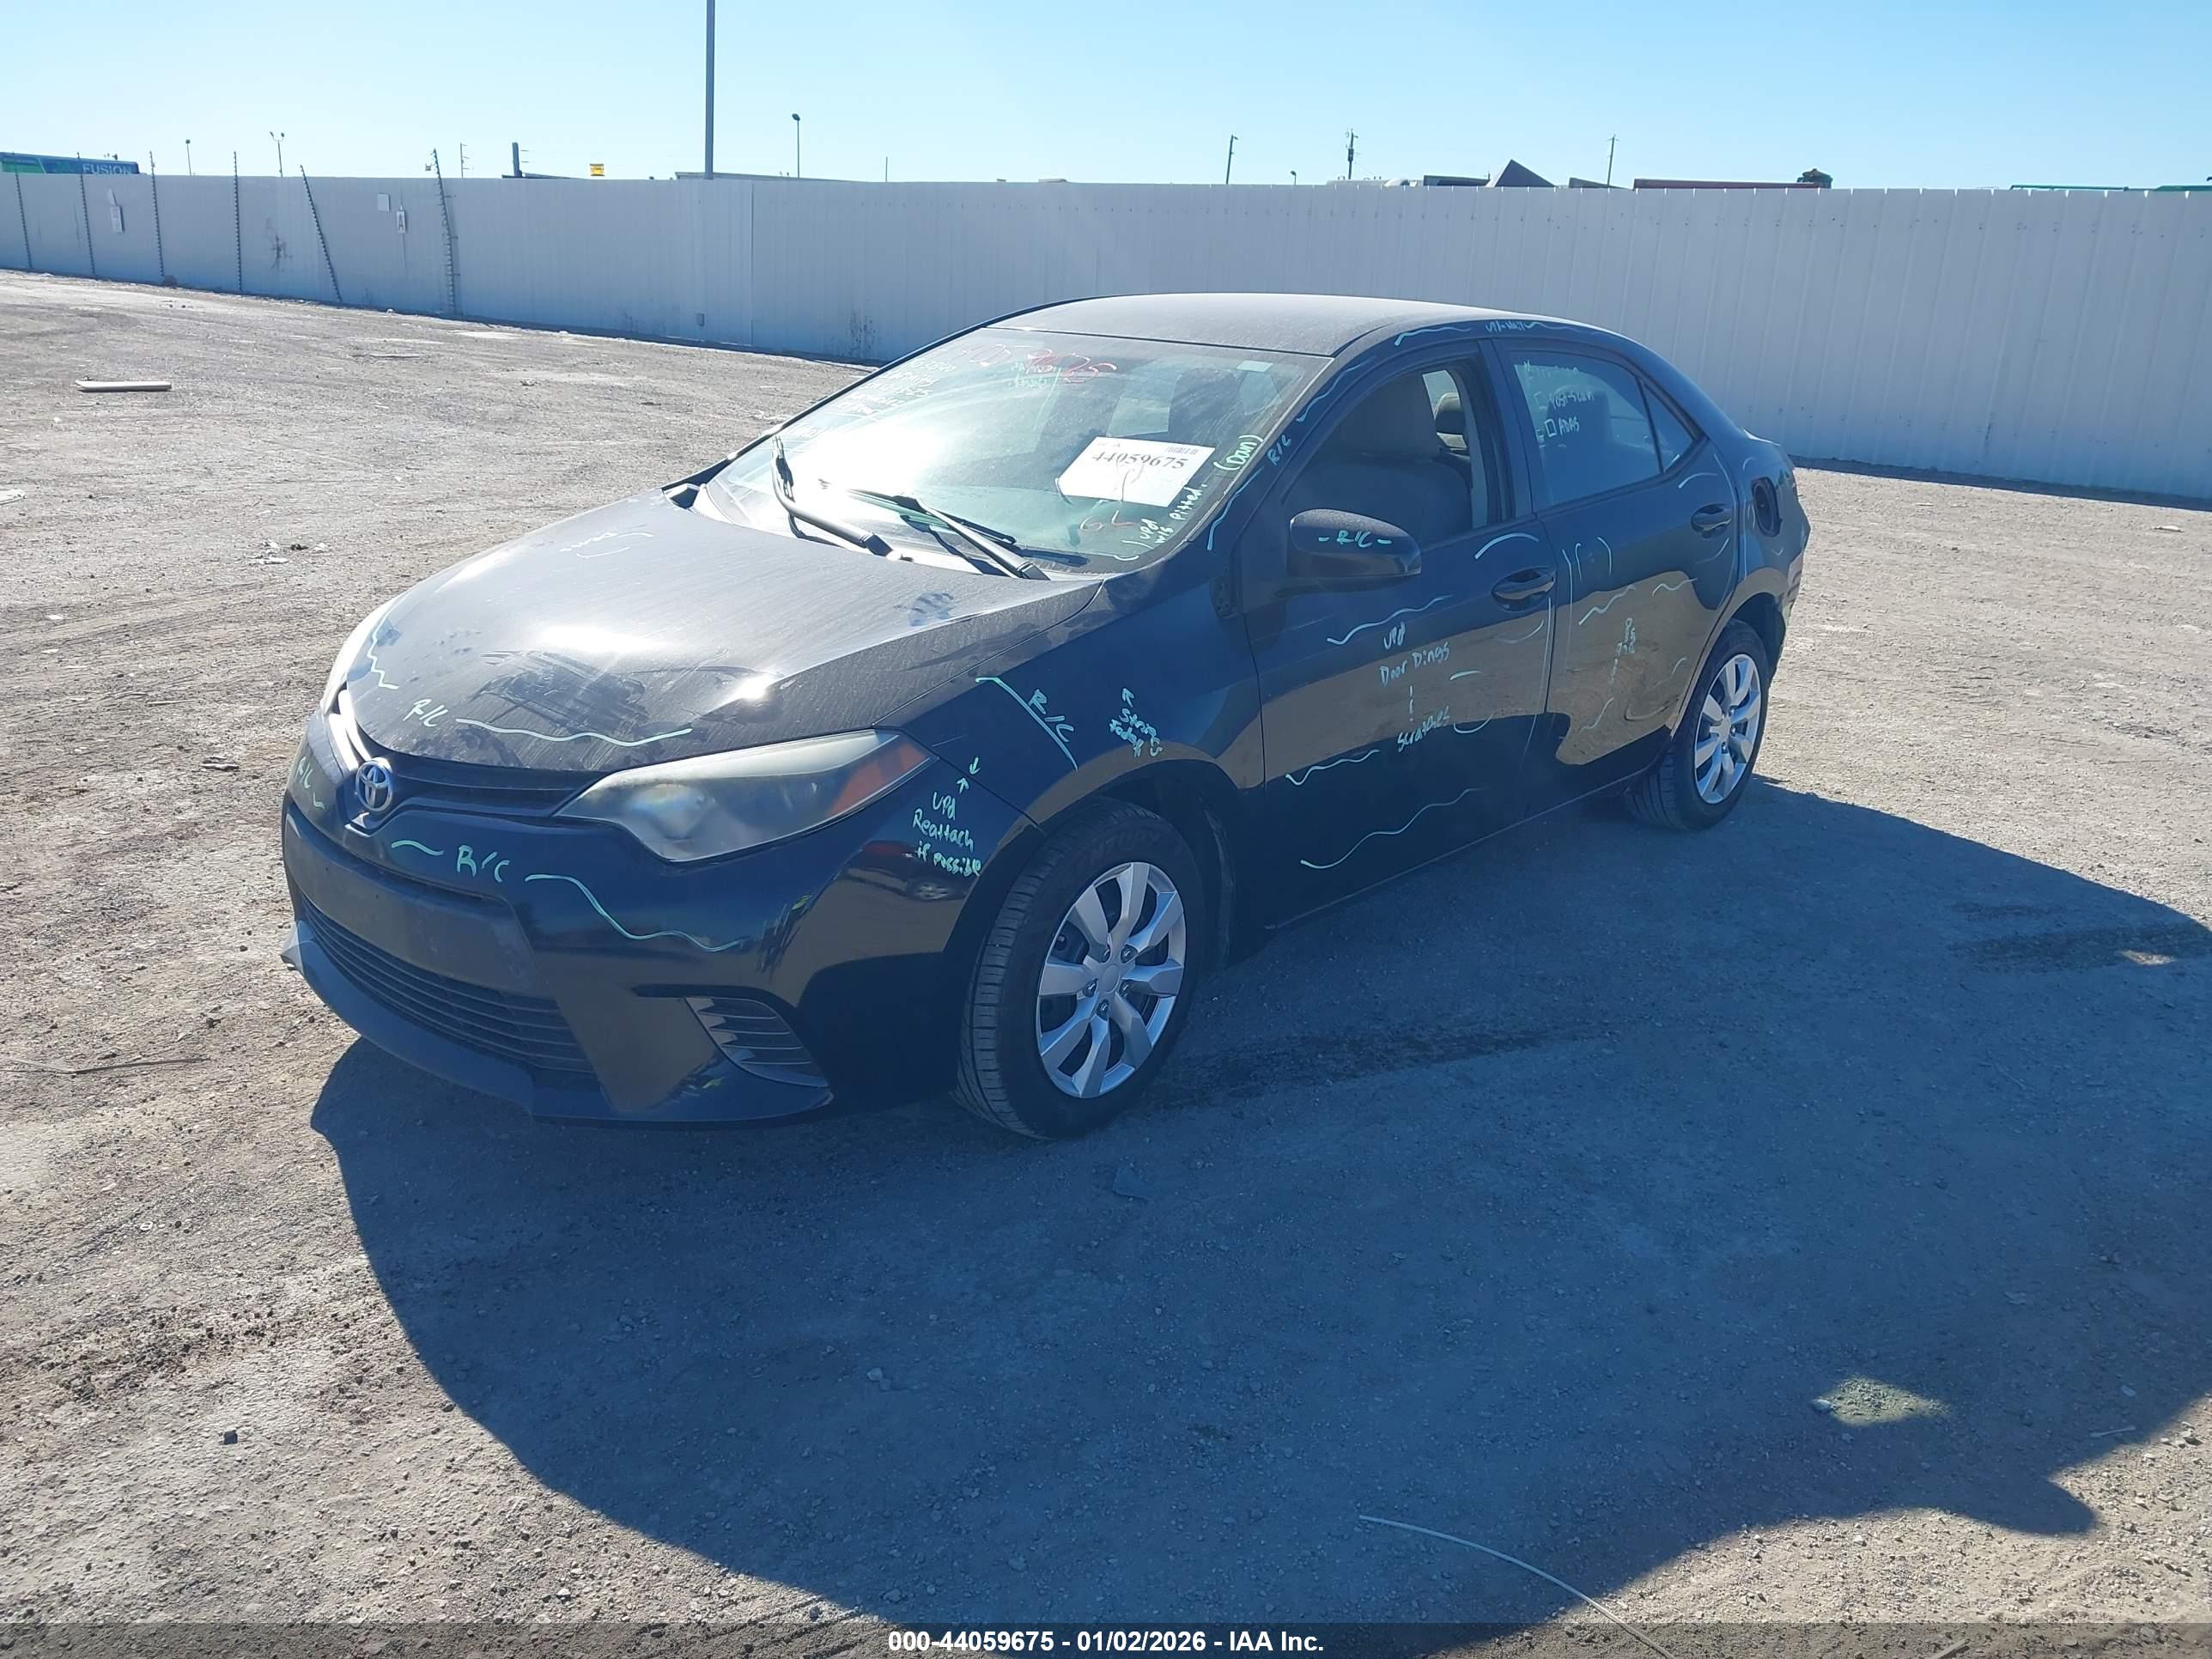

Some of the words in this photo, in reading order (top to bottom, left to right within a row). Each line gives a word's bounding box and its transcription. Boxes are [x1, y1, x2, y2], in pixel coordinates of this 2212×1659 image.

[1092, 451, 1189, 470] 44059675
[1380, 659, 1408, 687] Door
[1412, 641, 1450, 669] Dings
[913, 808, 975, 853] Reattach
[456, 844, 511, 884] R/C
